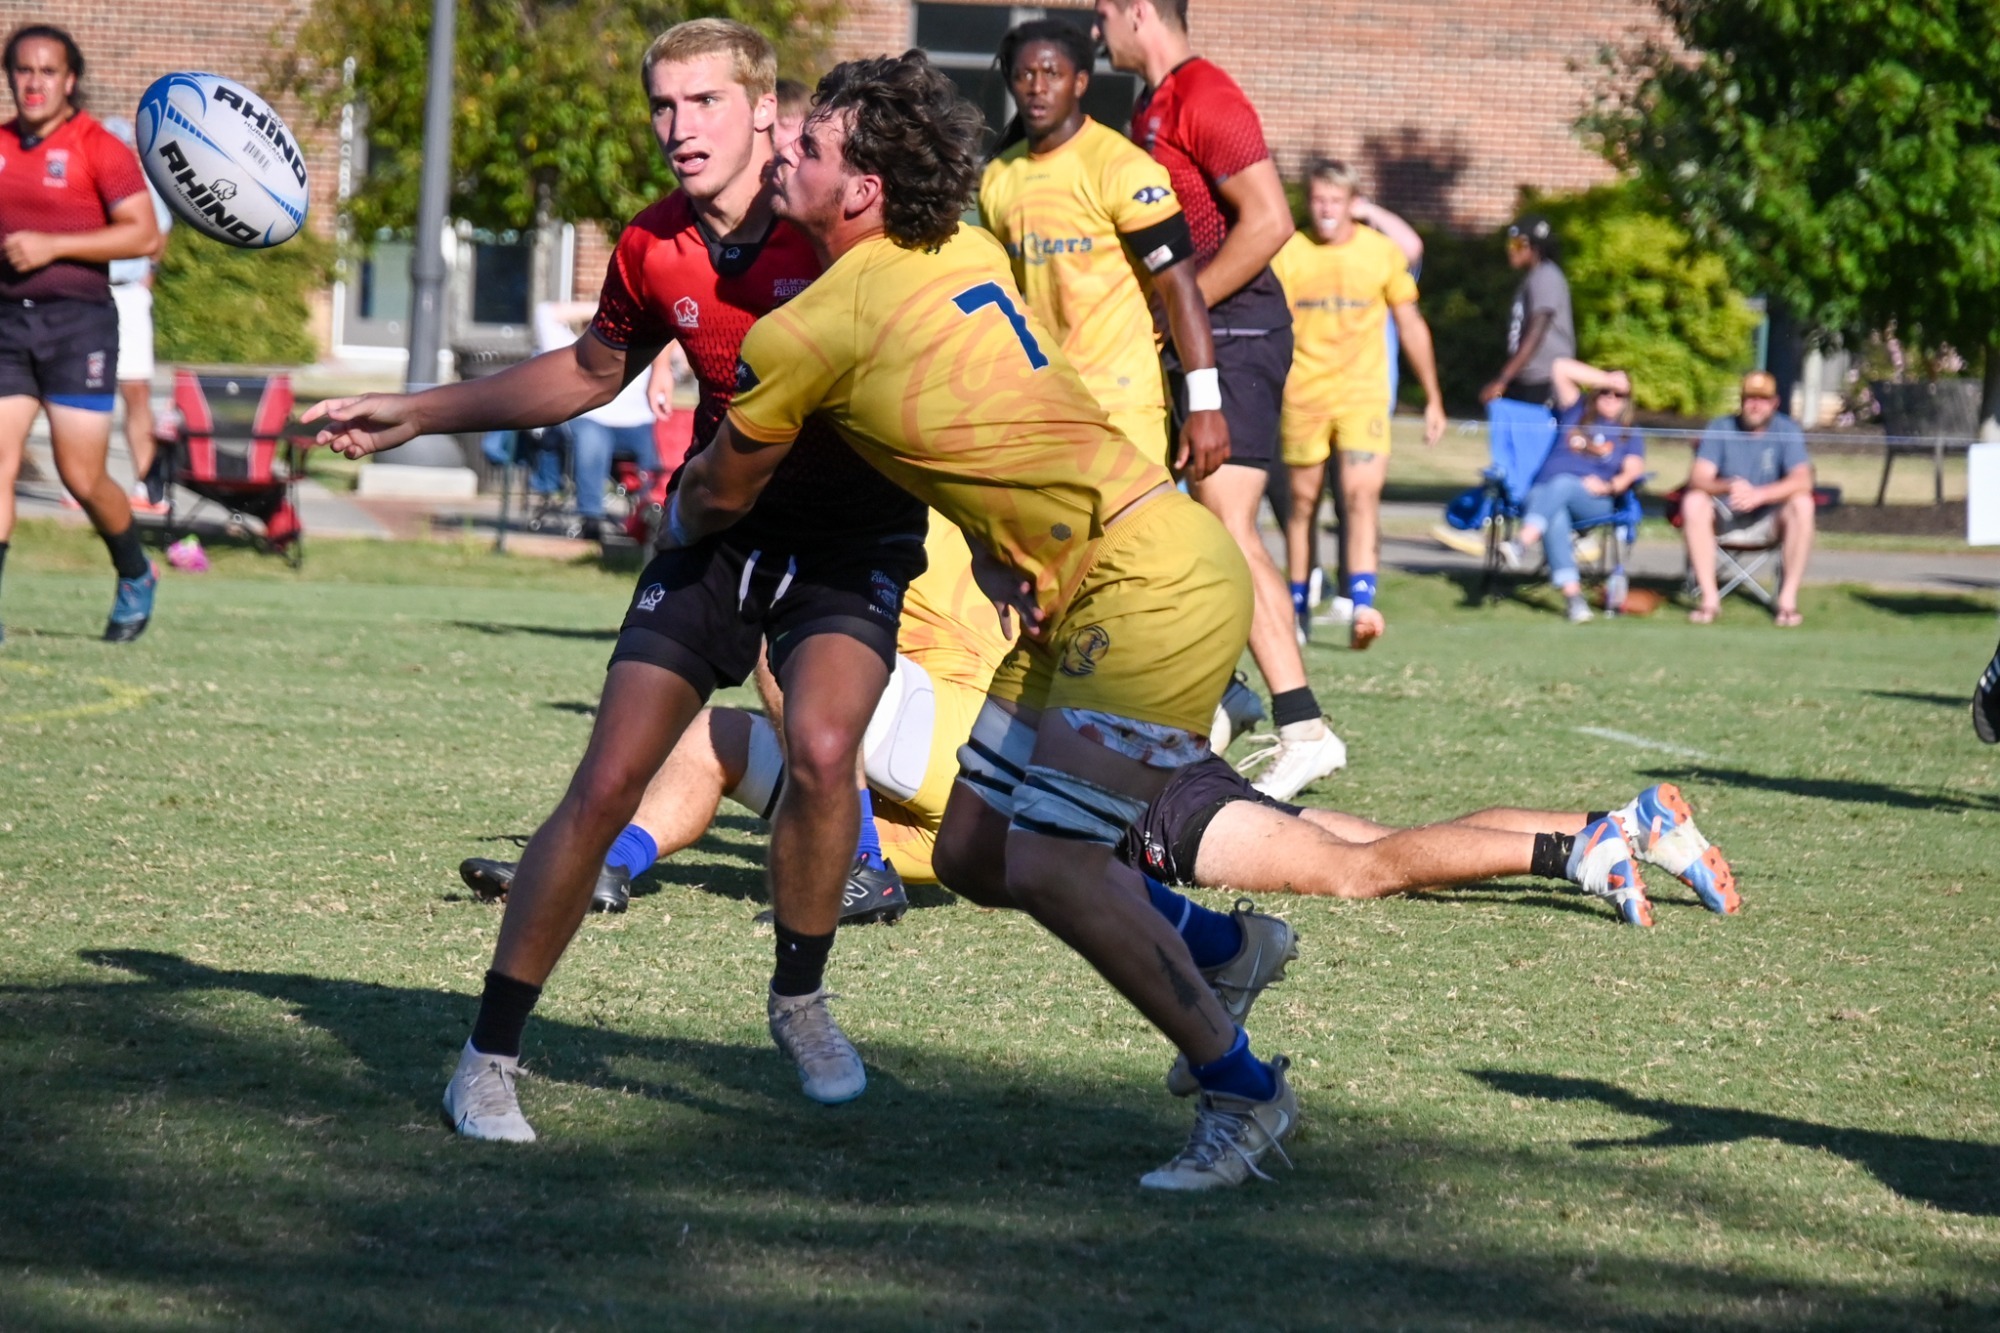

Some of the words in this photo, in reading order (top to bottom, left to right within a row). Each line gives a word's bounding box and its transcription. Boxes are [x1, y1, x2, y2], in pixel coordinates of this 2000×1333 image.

[213, 85, 307, 189] RHINO
[244, 121, 285, 164] HURRICANE
[159, 140, 261, 242] RHINO
[174, 183, 216, 228] HURRICANE
[951, 280, 1049, 370] 7
